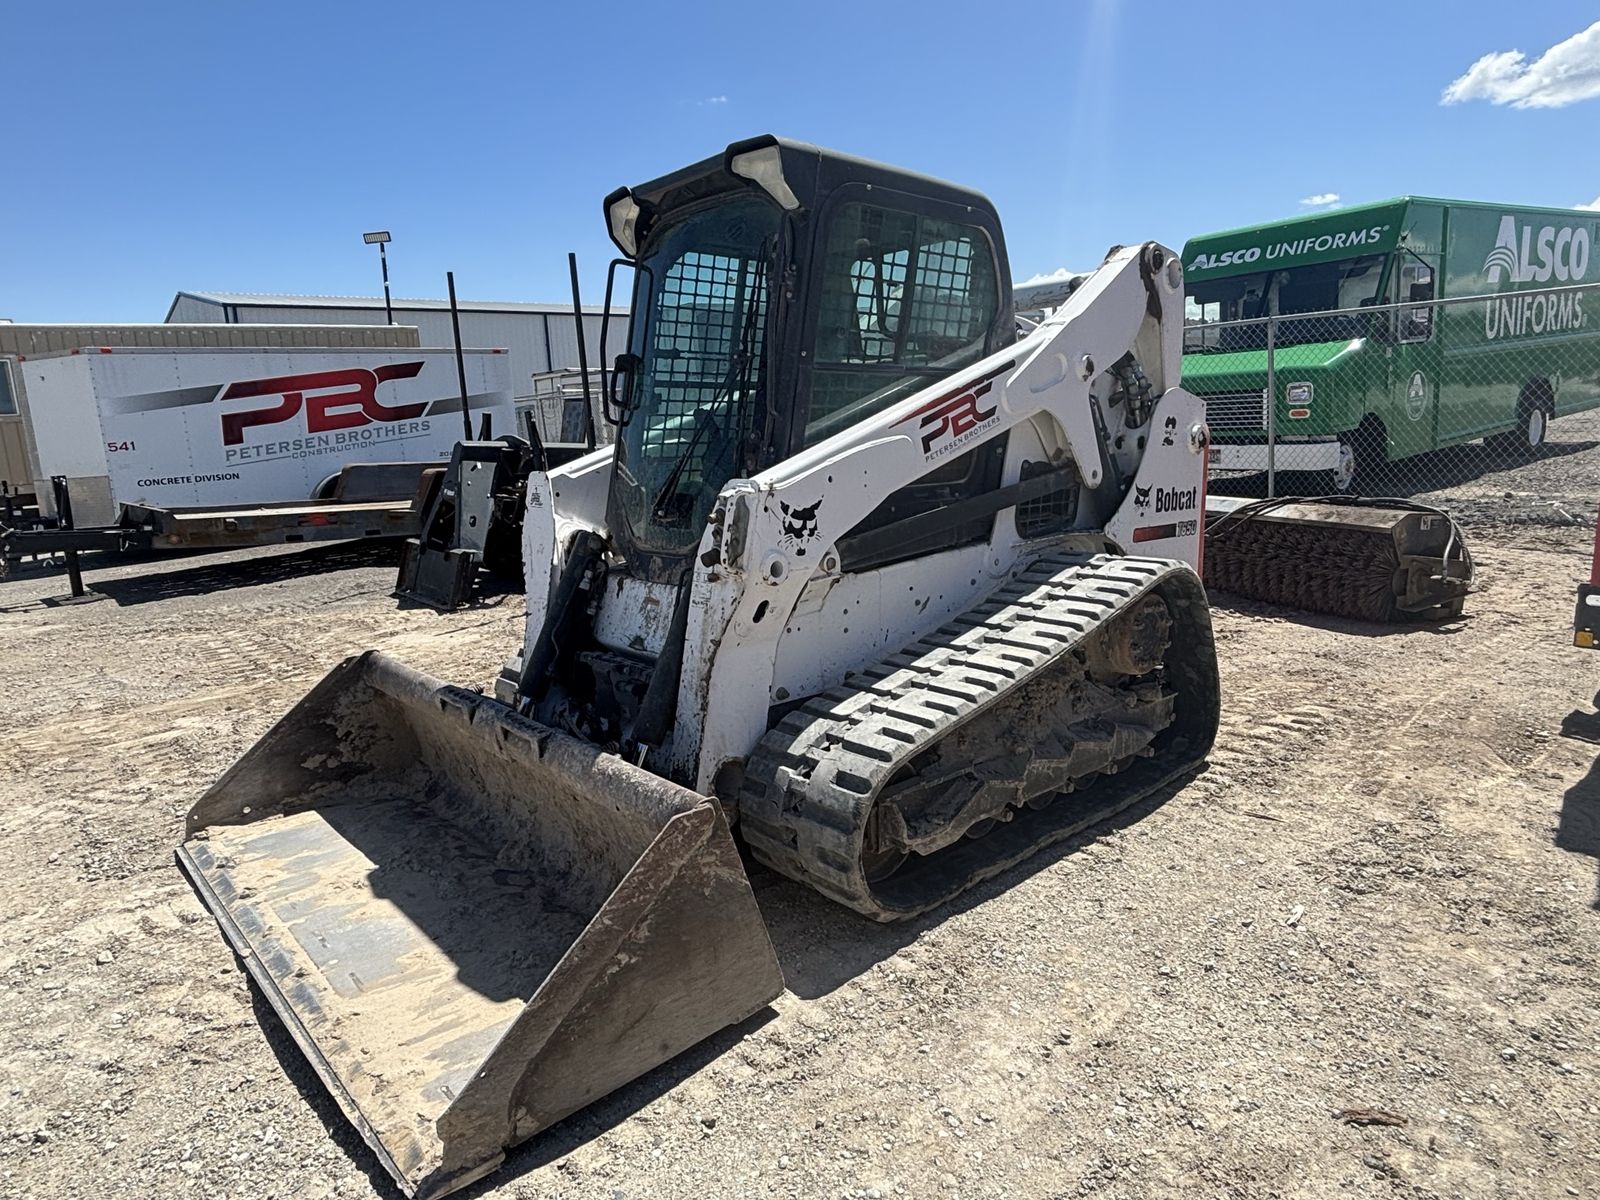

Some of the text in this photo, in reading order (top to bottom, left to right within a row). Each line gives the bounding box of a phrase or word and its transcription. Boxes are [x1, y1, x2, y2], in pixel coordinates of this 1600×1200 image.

[1187, 226, 1382, 272] ALSCO UNIFORMS
[1482, 215, 1589, 283] ALSCO
[1485, 291, 1584, 340] UNIFORMS
[220, 360, 430, 447] PBC
[919, 380, 998, 455] PBC
[107, 441, 136, 452] 541
[225, 420, 431, 462] PETERSEN BROTHERS
[291, 440, 376, 459] CONSTRUCTION
[925, 436, 964, 462] PETERSEN
[964, 415, 1001, 441] BROTHERS
[137, 472, 240, 487] CONCRETE DIVISION
[1155, 486, 1197, 513] Bobcat
[1177, 520, 1198, 538] T650
